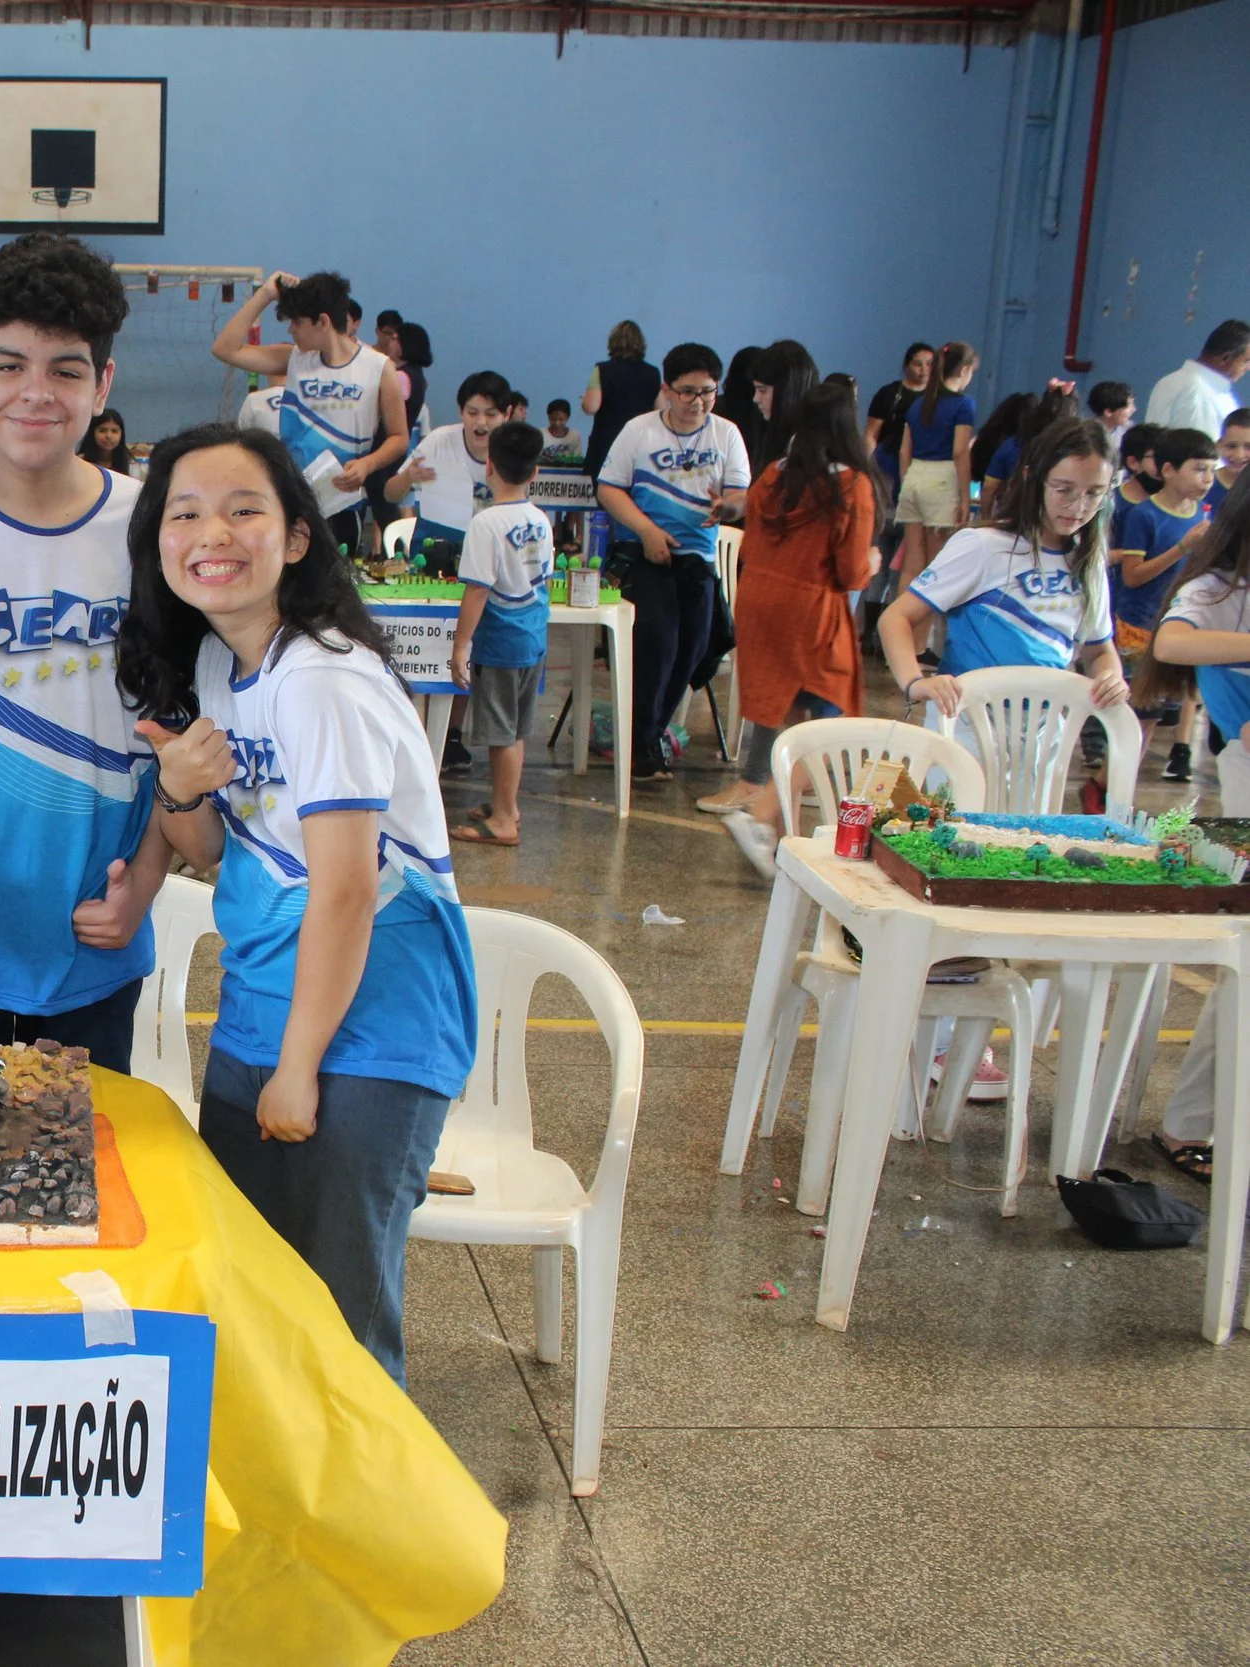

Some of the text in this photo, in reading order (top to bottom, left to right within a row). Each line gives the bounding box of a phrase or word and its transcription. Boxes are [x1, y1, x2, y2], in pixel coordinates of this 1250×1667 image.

[386, 623, 424, 636] EFÍCIOS
[427, 626, 441, 637] DO
[406, 645, 421, 655] AO
